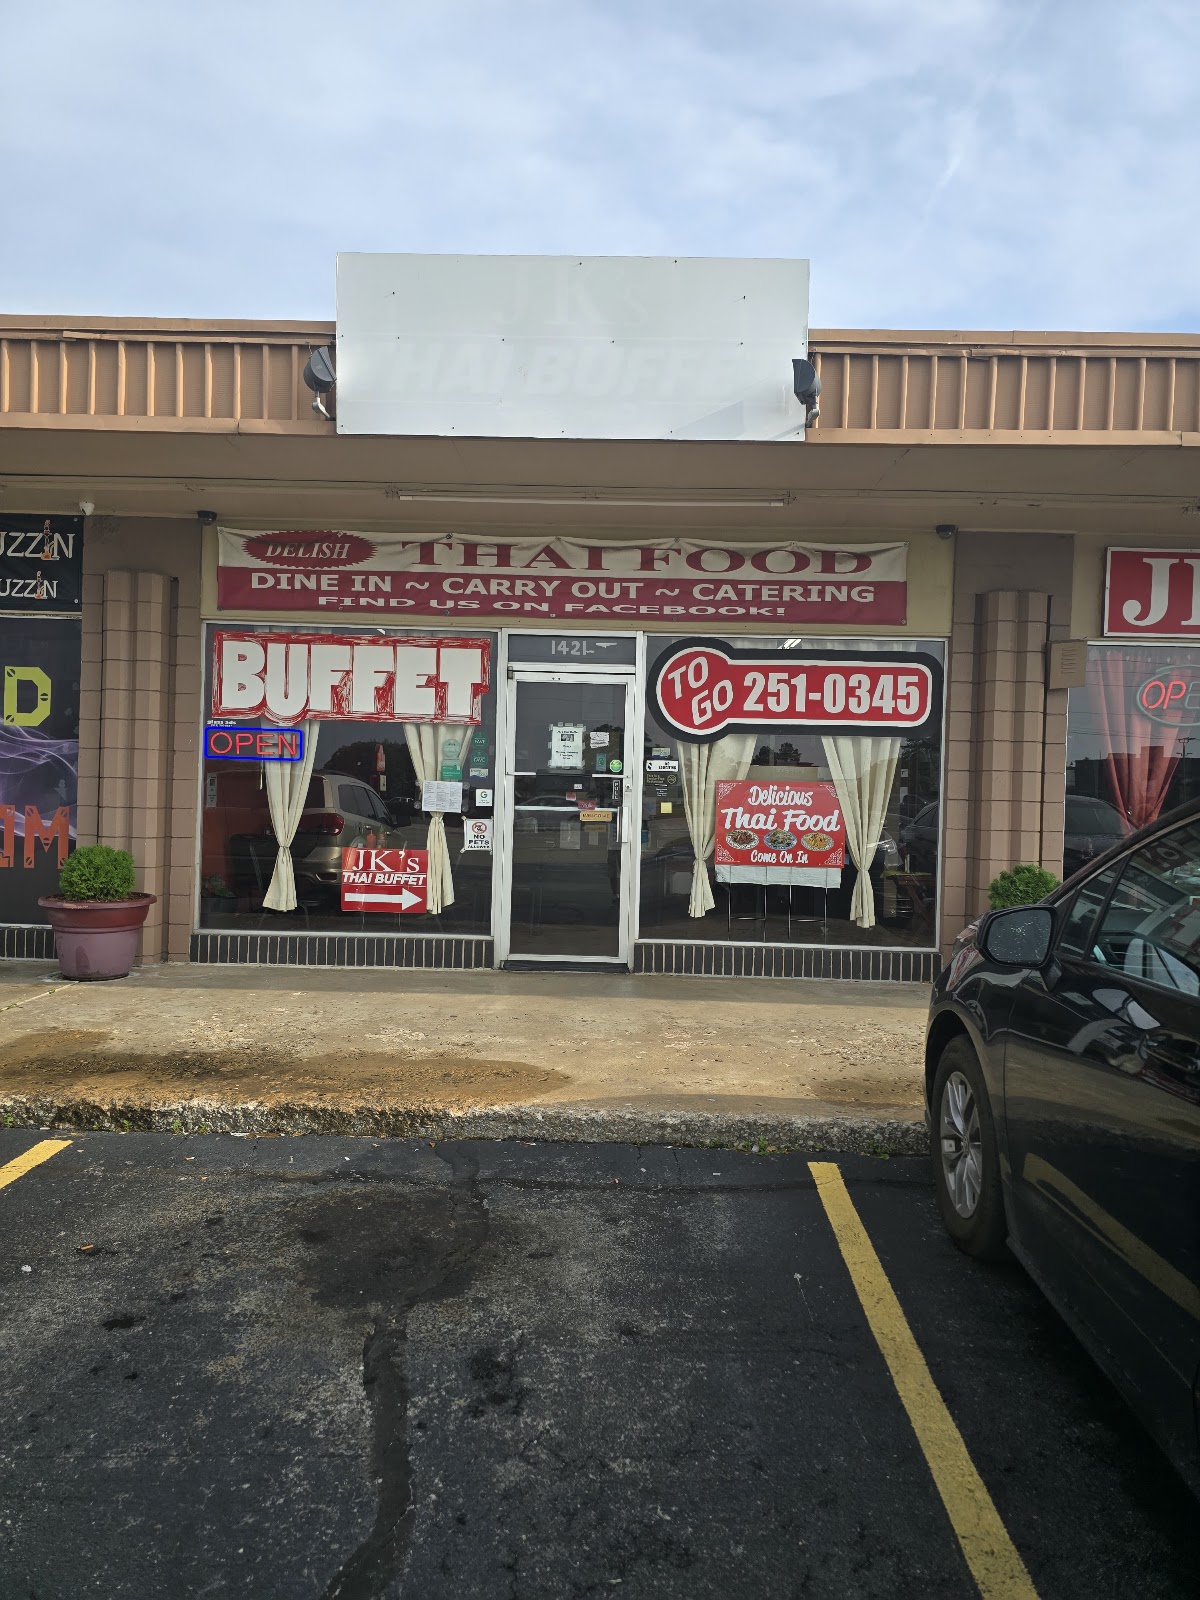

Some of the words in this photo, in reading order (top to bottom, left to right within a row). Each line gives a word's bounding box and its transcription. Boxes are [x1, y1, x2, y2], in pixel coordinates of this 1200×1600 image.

[264, 540, 352, 561] DELISH
[402, 540, 609, 571] THAI
[633, 546, 873, 575] FOOD
[251, 572, 339, 591] DINE
[351, 575, 392, 593] IN
[442, 577, 561, 597] CARRY
[571, 580, 644, 599] OUT
[692, 583, 875, 603] CATERING
[318, 596, 416, 607] FIND
[429, 600, 481, 610] US
[492, 601, 549, 612] ON
[564, 603, 786, 617] FACEBOOK!
[219, 636, 485, 721] BUFFET
[667, 656, 709, 699] TO
[4, 666, 51, 727] D
[691, 679, 734, 726] GO
[742, 671, 920, 715] 251-0345
[210, 731, 297, 755] OPEN
[747, 784, 814, 807] Delicious
[721, 806, 778, 830] Thai
[781, 808, 841, 832] Food
[750, 849, 778, 863] Come
[779, 850, 794, 863] On
[796, 850, 809, 864] In
[342, 871, 373, 884] THAI
[374, 873, 427, 886] BUFFET
